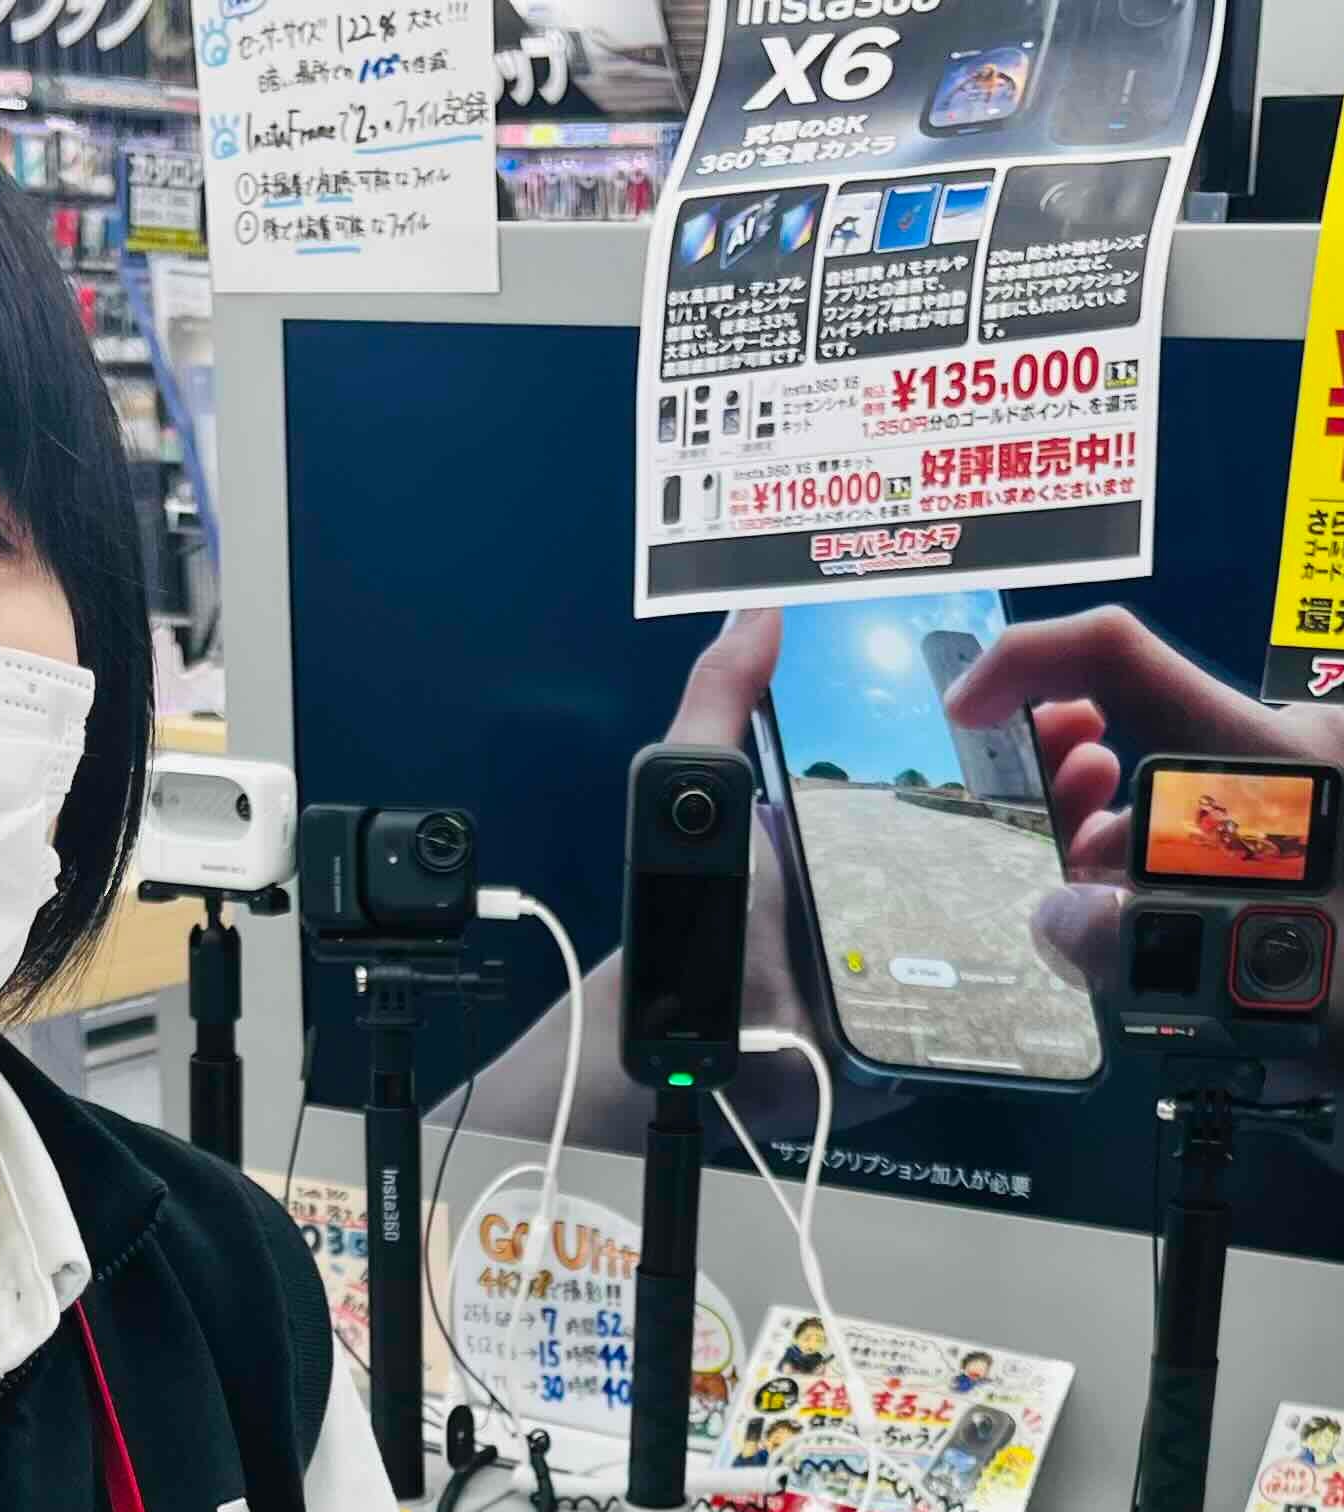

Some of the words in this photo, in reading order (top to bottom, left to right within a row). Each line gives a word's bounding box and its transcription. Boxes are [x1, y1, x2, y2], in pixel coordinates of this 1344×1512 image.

[337, 11, 397, 53] 122%
[741, 25, 903, 112] X6
[892, 346, 1100, 413] ¥135,000
[921, 431, 1136, 489] 好評販売中!!
[753, 472, 882, 513] ¥118,000
[381, 1167, 401, 1243] Insta360
